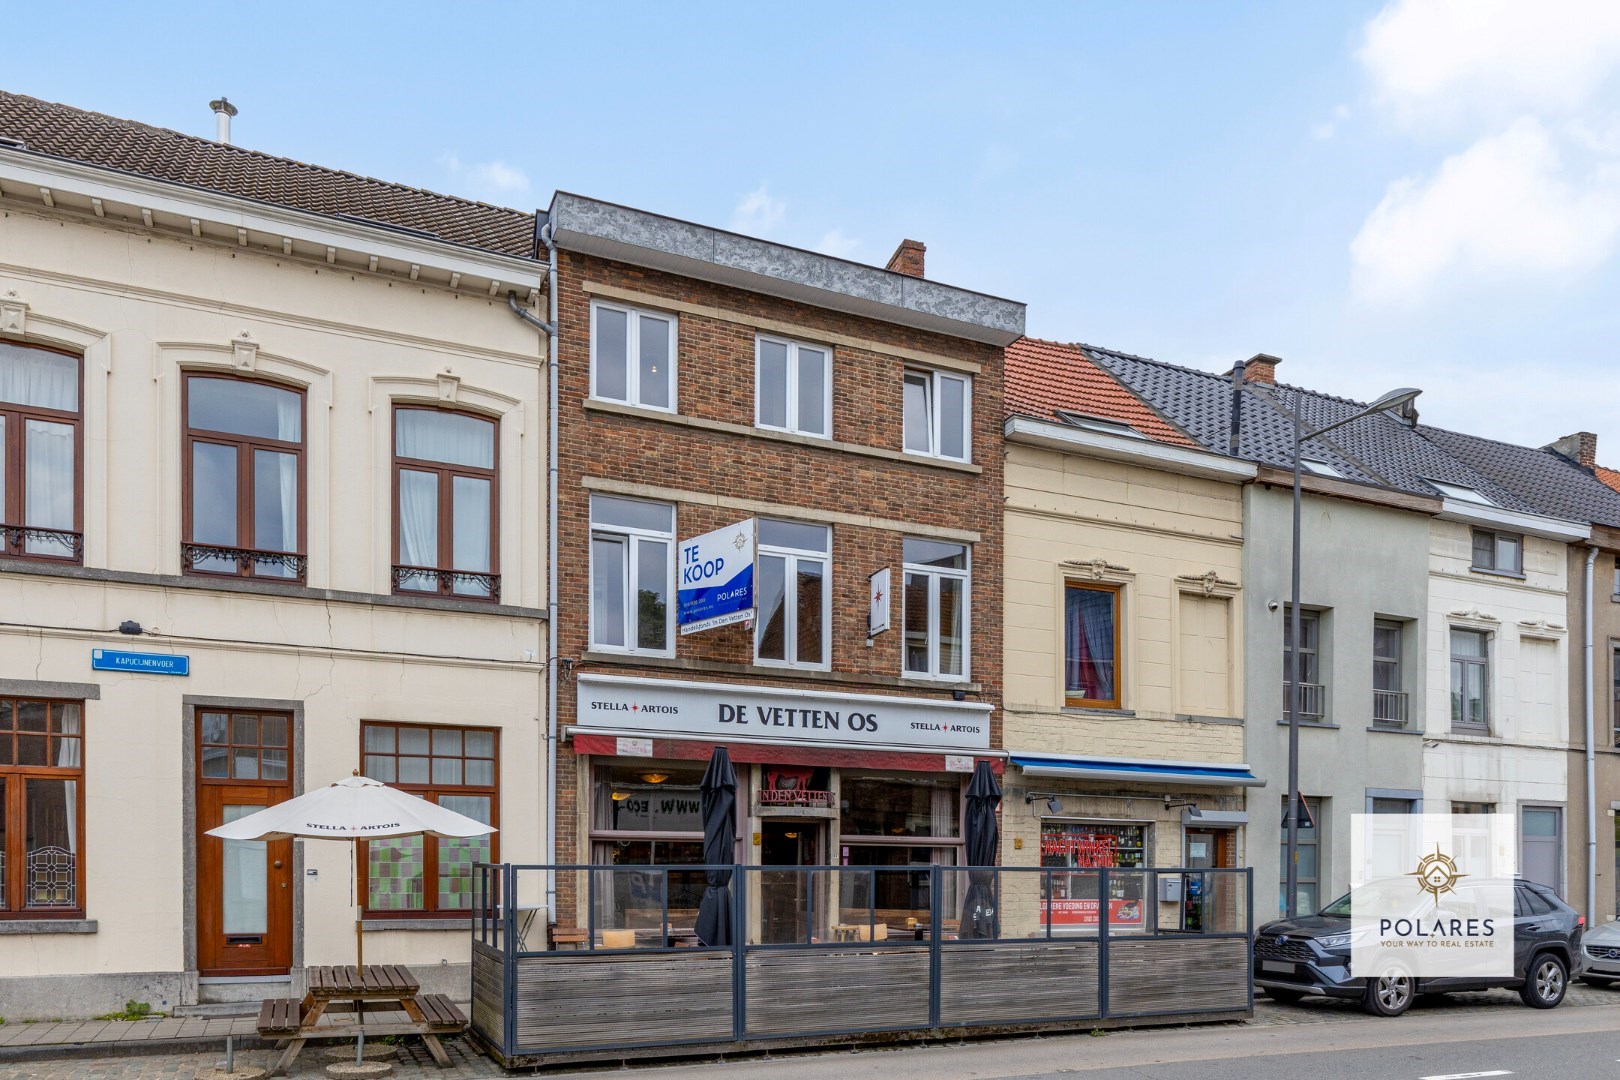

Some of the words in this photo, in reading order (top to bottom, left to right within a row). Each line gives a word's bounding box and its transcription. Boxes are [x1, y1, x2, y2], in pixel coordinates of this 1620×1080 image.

[684, 545, 699, 564] TE
[684, 558, 724, 584] KOOP
[717, 587, 747, 601] POLARES
[116, 657, 174, 668] KAPUCIJNENVOER
[591, 701, 629, 711] STELLA
[641, 704, 679, 714] ARTOIS
[718, 703, 748, 724] DE
[756, 706, 840, 730] VETTEN
[847, 712, 879, 732] OS
[910, 722, 940, 731] STELLA
[950, 725, 980, 733] ARTOIS
[306, 823, 347, 831] STELLA
[360, 823, 401, 831] ARTOIS
[1044, 839, 1113, 855] NACHTWINKEL
